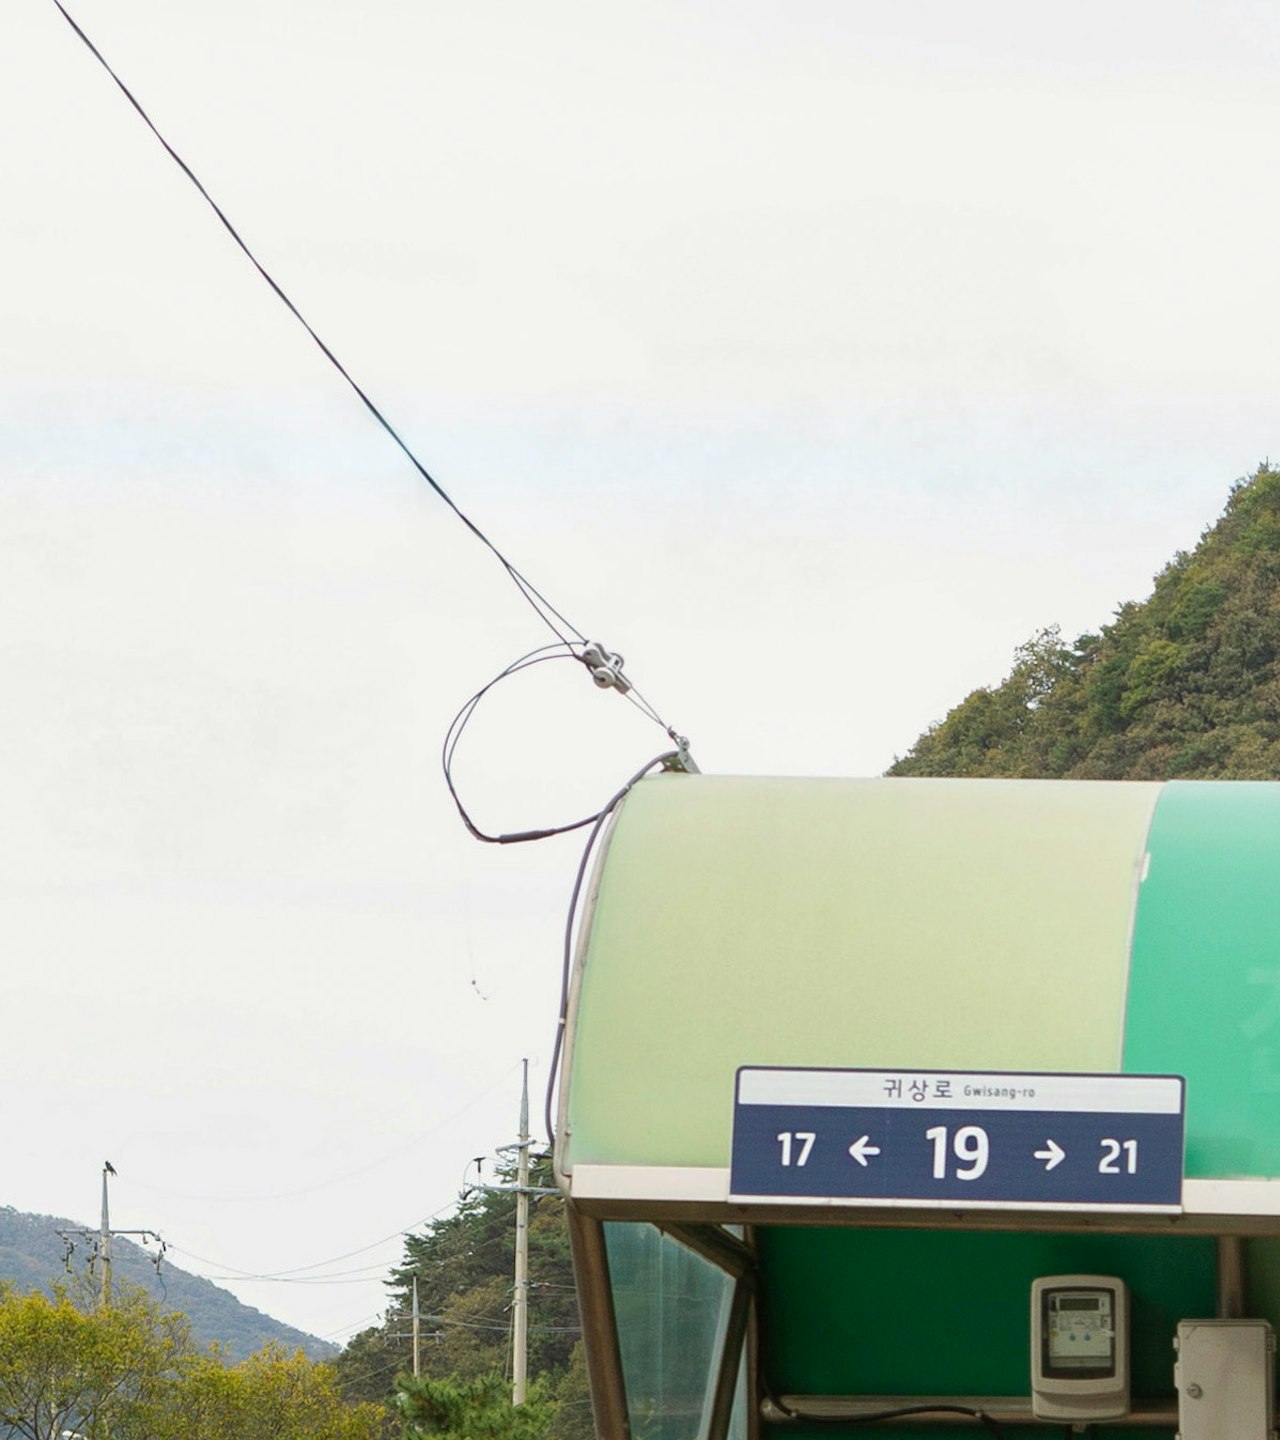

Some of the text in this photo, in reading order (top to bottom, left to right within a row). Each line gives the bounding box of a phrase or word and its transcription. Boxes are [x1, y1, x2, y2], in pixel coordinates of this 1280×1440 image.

[883, 1078, 1036, 1102] 귀상로 Gwisang-ro
[777, 1125, 1138, 1180] 17 19 21
